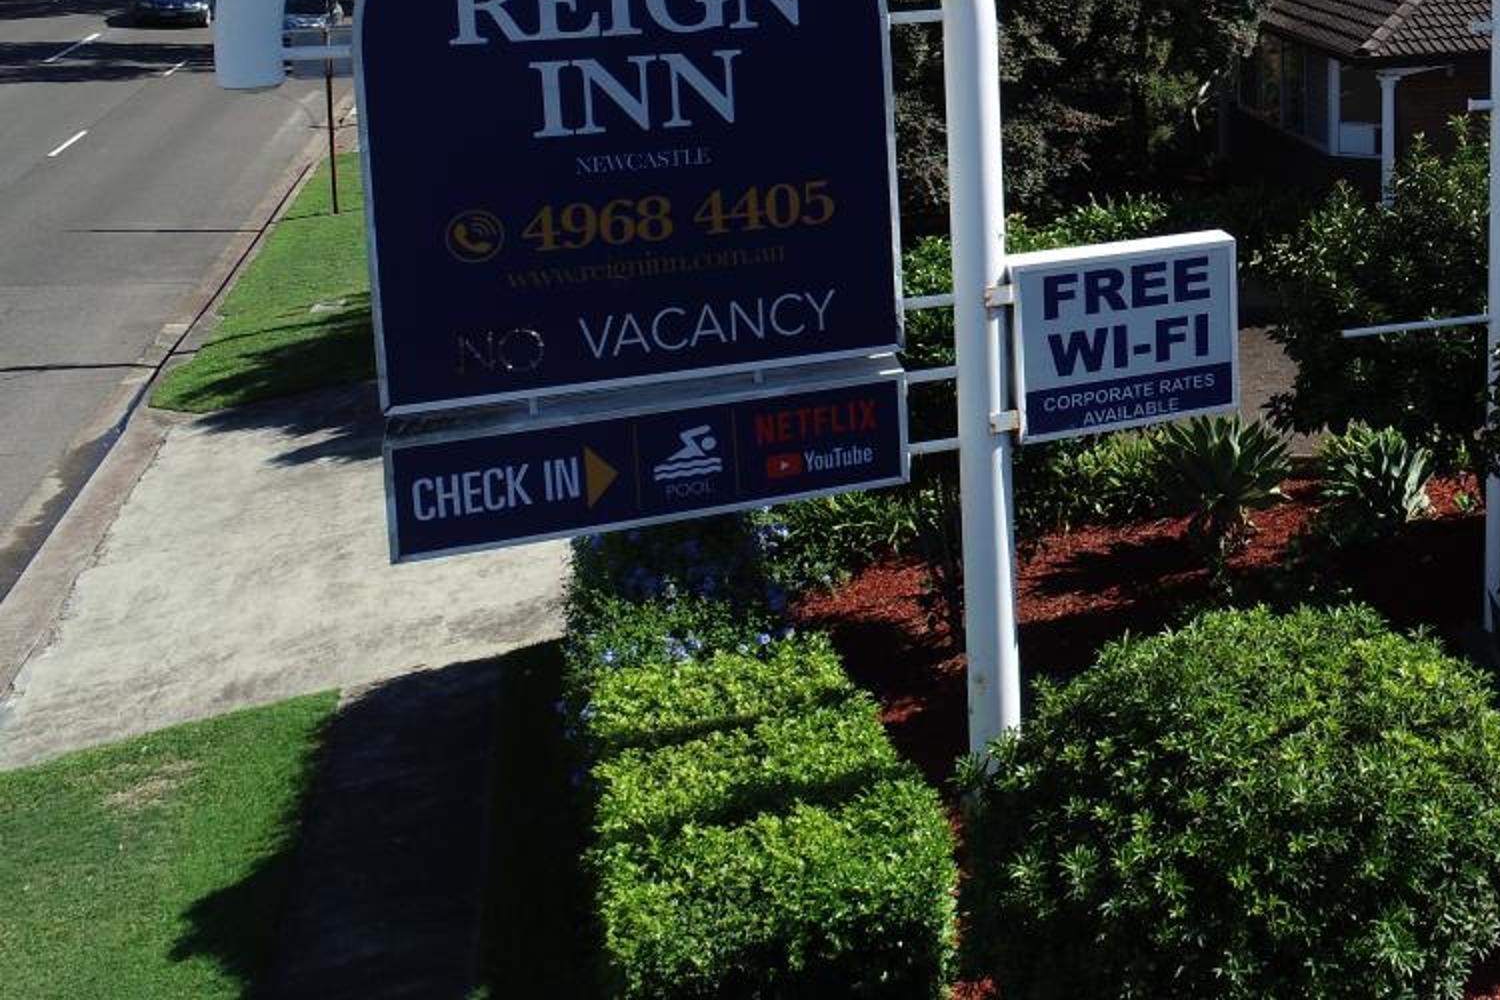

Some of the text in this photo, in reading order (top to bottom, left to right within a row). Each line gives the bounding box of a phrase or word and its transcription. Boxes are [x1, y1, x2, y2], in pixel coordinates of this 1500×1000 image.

[528, 49, 743, 138] INN
[575, 147, 713, 175] NEWCASTLE
[521, 180, 835, 252] 4968 4405
[1043, 256, 1210, 320] FREE
[455, 289, 836, 374] NO VACANCY
[1048, 313, 1209, 377] WI-FI
[1043, 373, 1216, 412] CORPORATE RATES
[1083, 398, 1180, 425] AVAILABLE
[754, 401, 878, 442] NETFLIX
[803, 445, 874, 472] YouTube
[411, 456, 582, 521] CHECK IN
[665, 481, 716, 498] POOL
